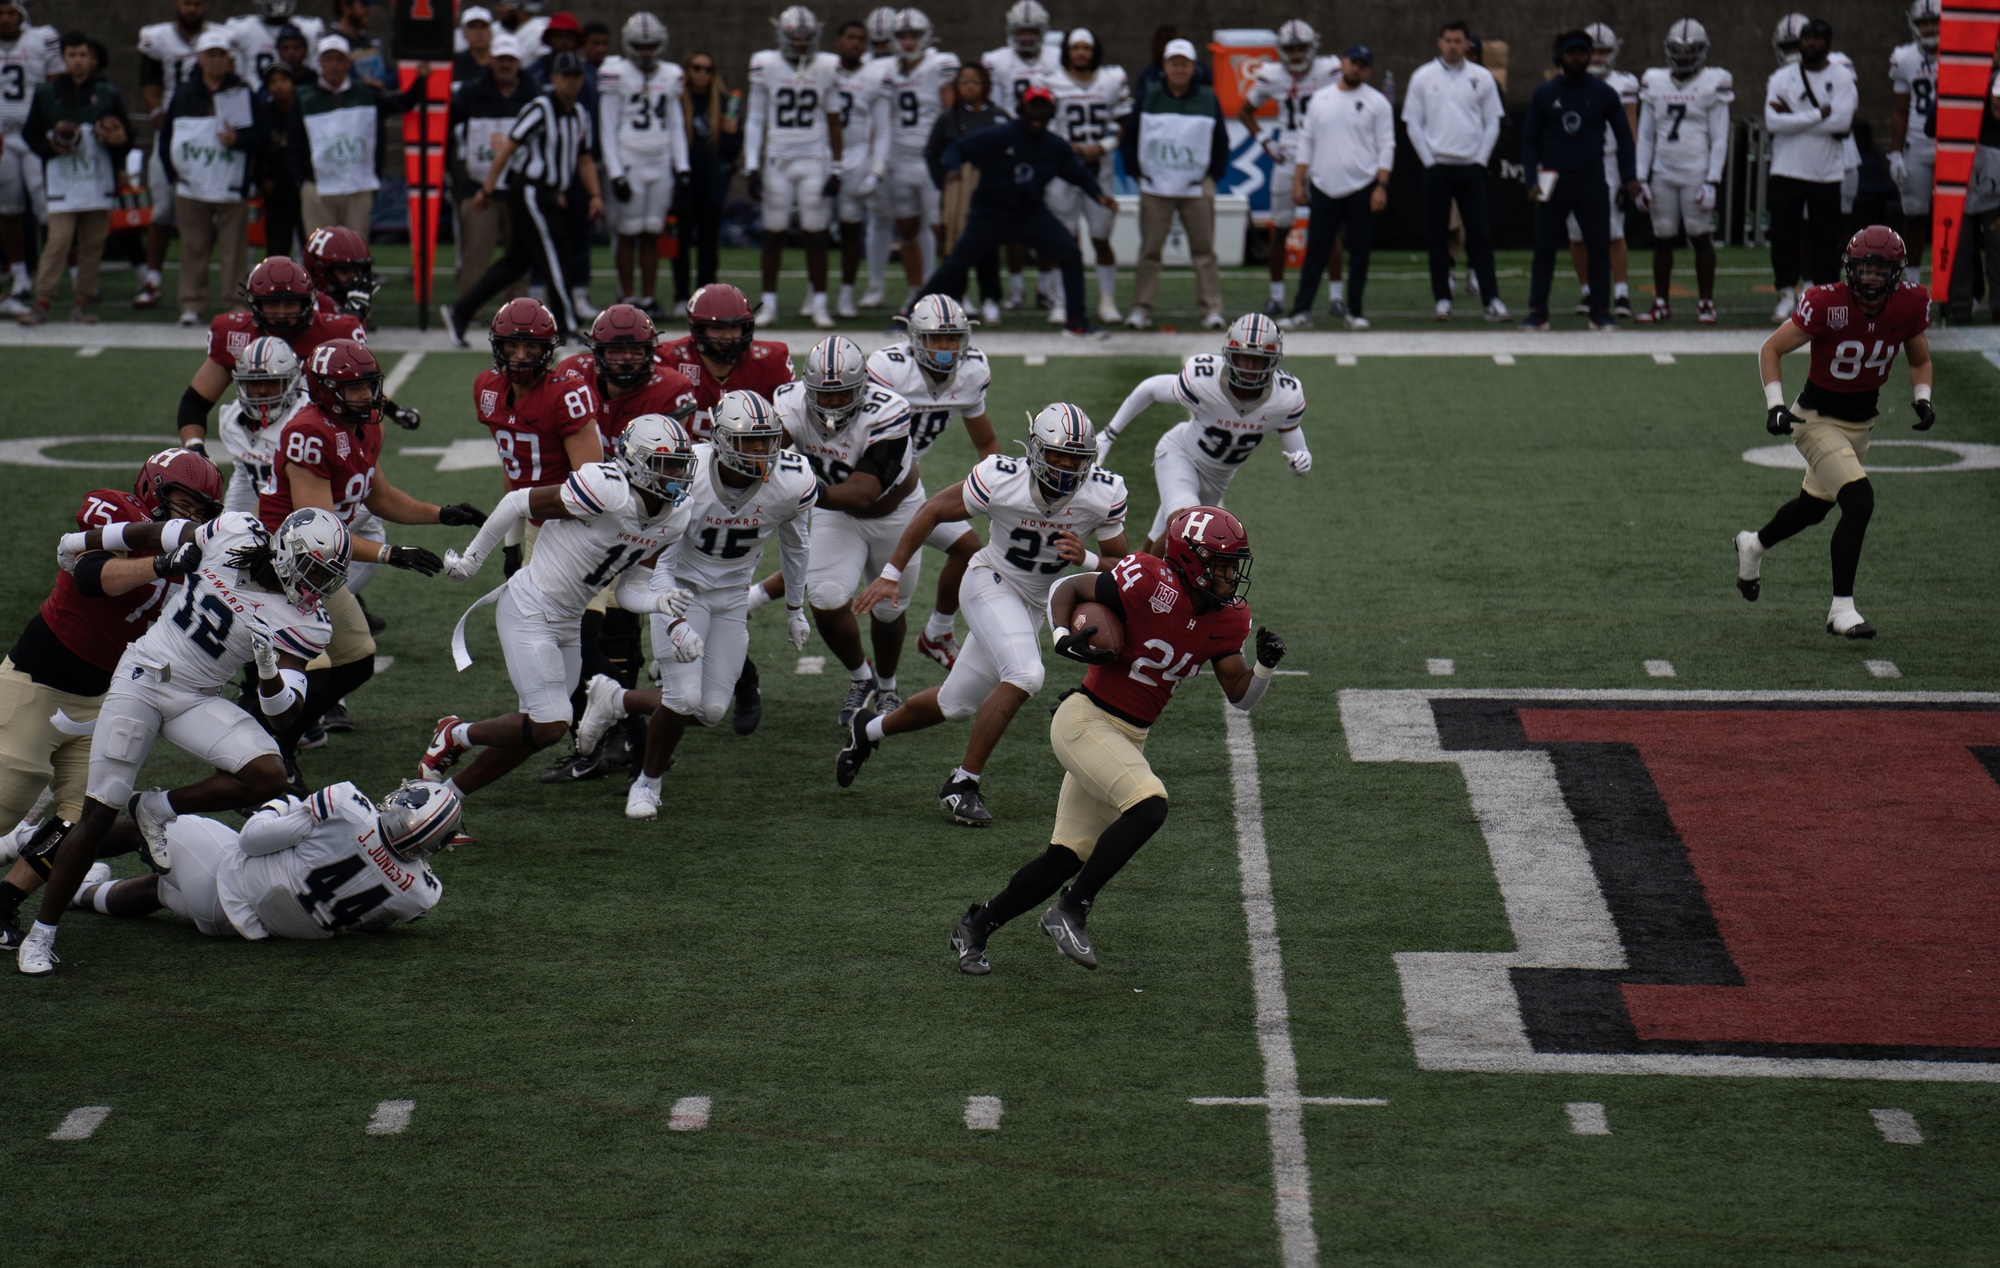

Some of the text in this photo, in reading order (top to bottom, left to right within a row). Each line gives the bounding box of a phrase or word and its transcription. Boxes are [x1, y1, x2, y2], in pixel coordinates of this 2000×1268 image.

[632, 95, 667, 130] 34
[778, 88, 817, 127] 22
[900, 91, 917, 126] 9
[1067, 104, 1106, 142] 25
[1667, 103, 1686, 141] 7
[308, 229, 334, 257] H
[1831, 309, 1846, 320] 150
[1868, 322, 1876, 332] H
[230, 334, 249, 348] 150
[311, 346, 337, 375] H
[1194, 355, 1214, 378] 32
[1830, 339, 1895, 380] 84
[482, 392, 495, 408] 150
[564, 385, 594, 419] 87
[508, 415, 516, 424] H
[909, 411, 949, 450] 18
[1217, 418, 1263, 431] HOWARD
[150, 448, 190, 468] H
[286, 432, 323, 465] 86
[495, 429, 542, 481] 87
[805, 444, 848, 459] HOWARD
[1198, 426, 1264, 464] 32
[780, 450, 804, 475] 15
[83, 496, 118, 529] 75
[706, 516, 759, 527] HOWARD
[1021, 518, 1073, 530] HOWARD
[1181, 511, 1214, 541] H
[617, 532, 658, 548] HOWARD
[695, 526, 760, 560] 15
[583, 544, 647, 587] 11
[1111, 554, 1143, 593] 24
[201, 567, 245, 614] HOWARD
[1157, 585, 1175, 605] 150
[172, 573, 234, 660] 12
[1186, 618, 1197, 630] H
[1128, 638, 1200, 696] 24
[358, 829, 375, 848] J.
[397, 873, 416, 892] II
[297, 854, 391, 931] 44
